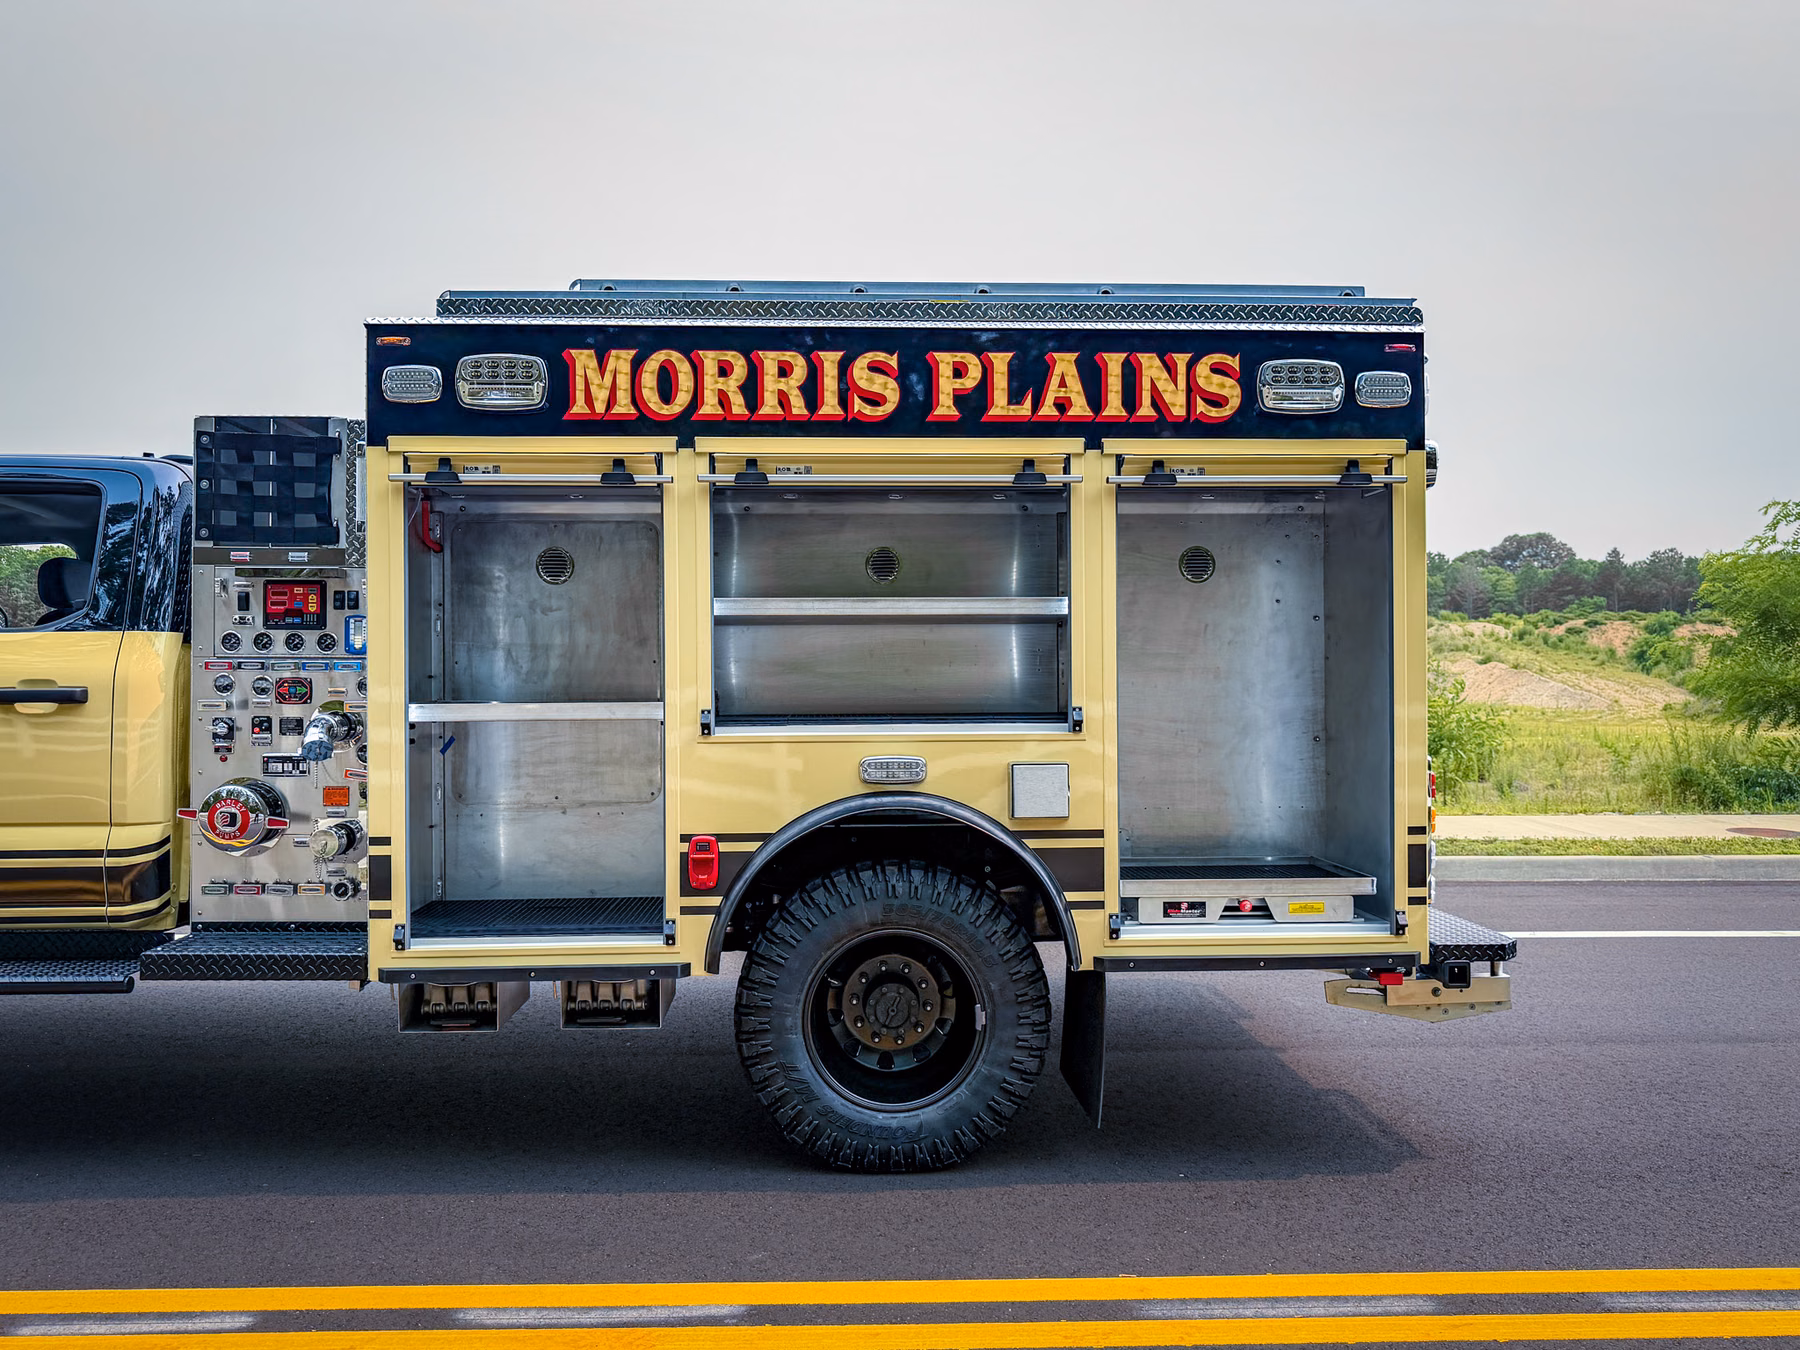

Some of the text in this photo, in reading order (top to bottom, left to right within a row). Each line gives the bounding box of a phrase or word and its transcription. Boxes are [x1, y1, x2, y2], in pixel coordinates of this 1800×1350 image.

[562, 349, 1241, 422] MORRIS PLAINS
[215, 799, 247, 812] DARLEY
[215, 829, 241, 839] PUMPS
